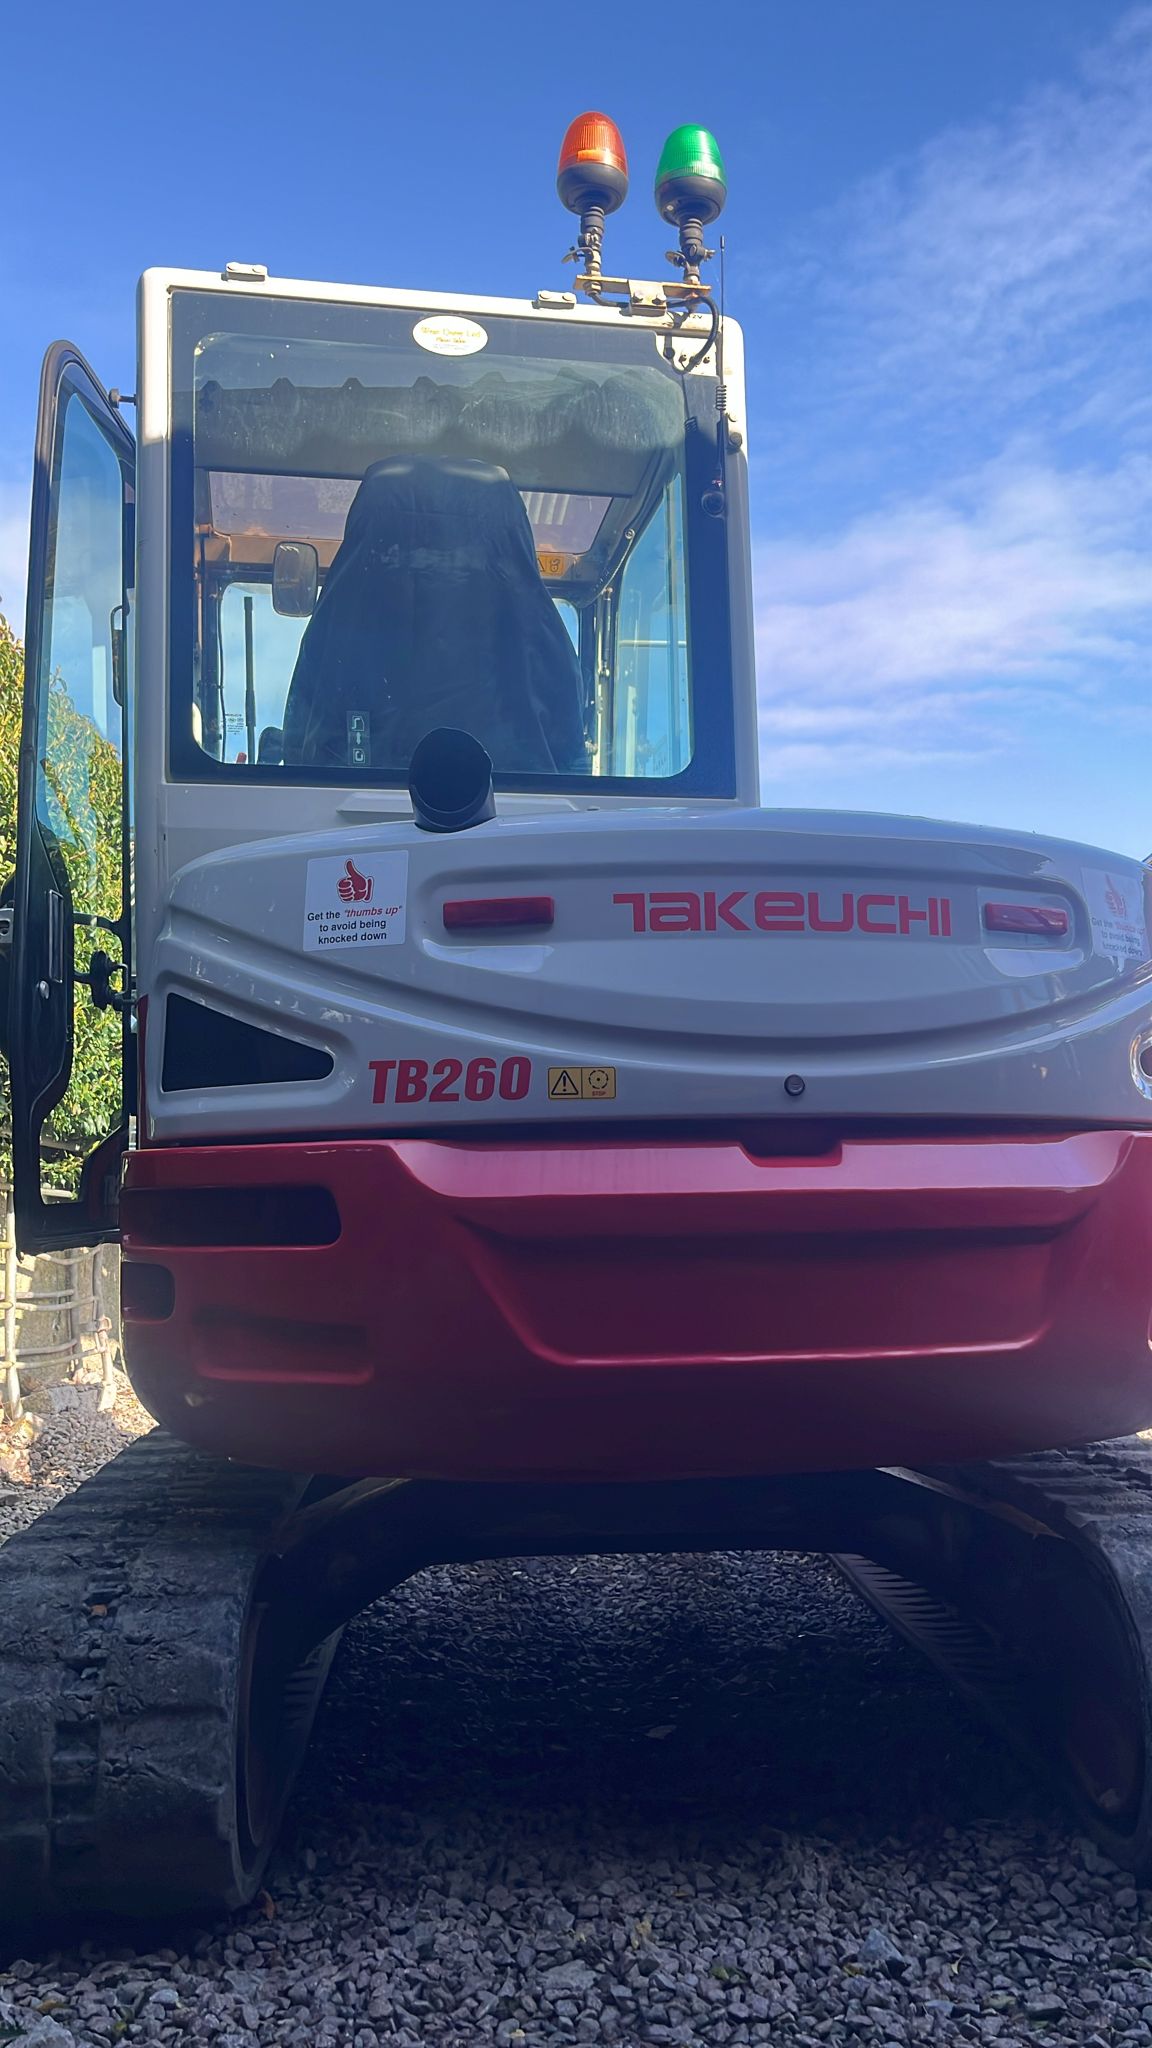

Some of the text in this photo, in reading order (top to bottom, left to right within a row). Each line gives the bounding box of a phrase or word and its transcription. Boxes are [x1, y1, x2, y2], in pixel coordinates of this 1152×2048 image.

[307, 905, 403, 921] Get the "thumbs up"
[319, 919, 387, 932] to avoid being
[318, 932, 387, 944] knocked down
[367, 1056, 532, 1105] TB260
